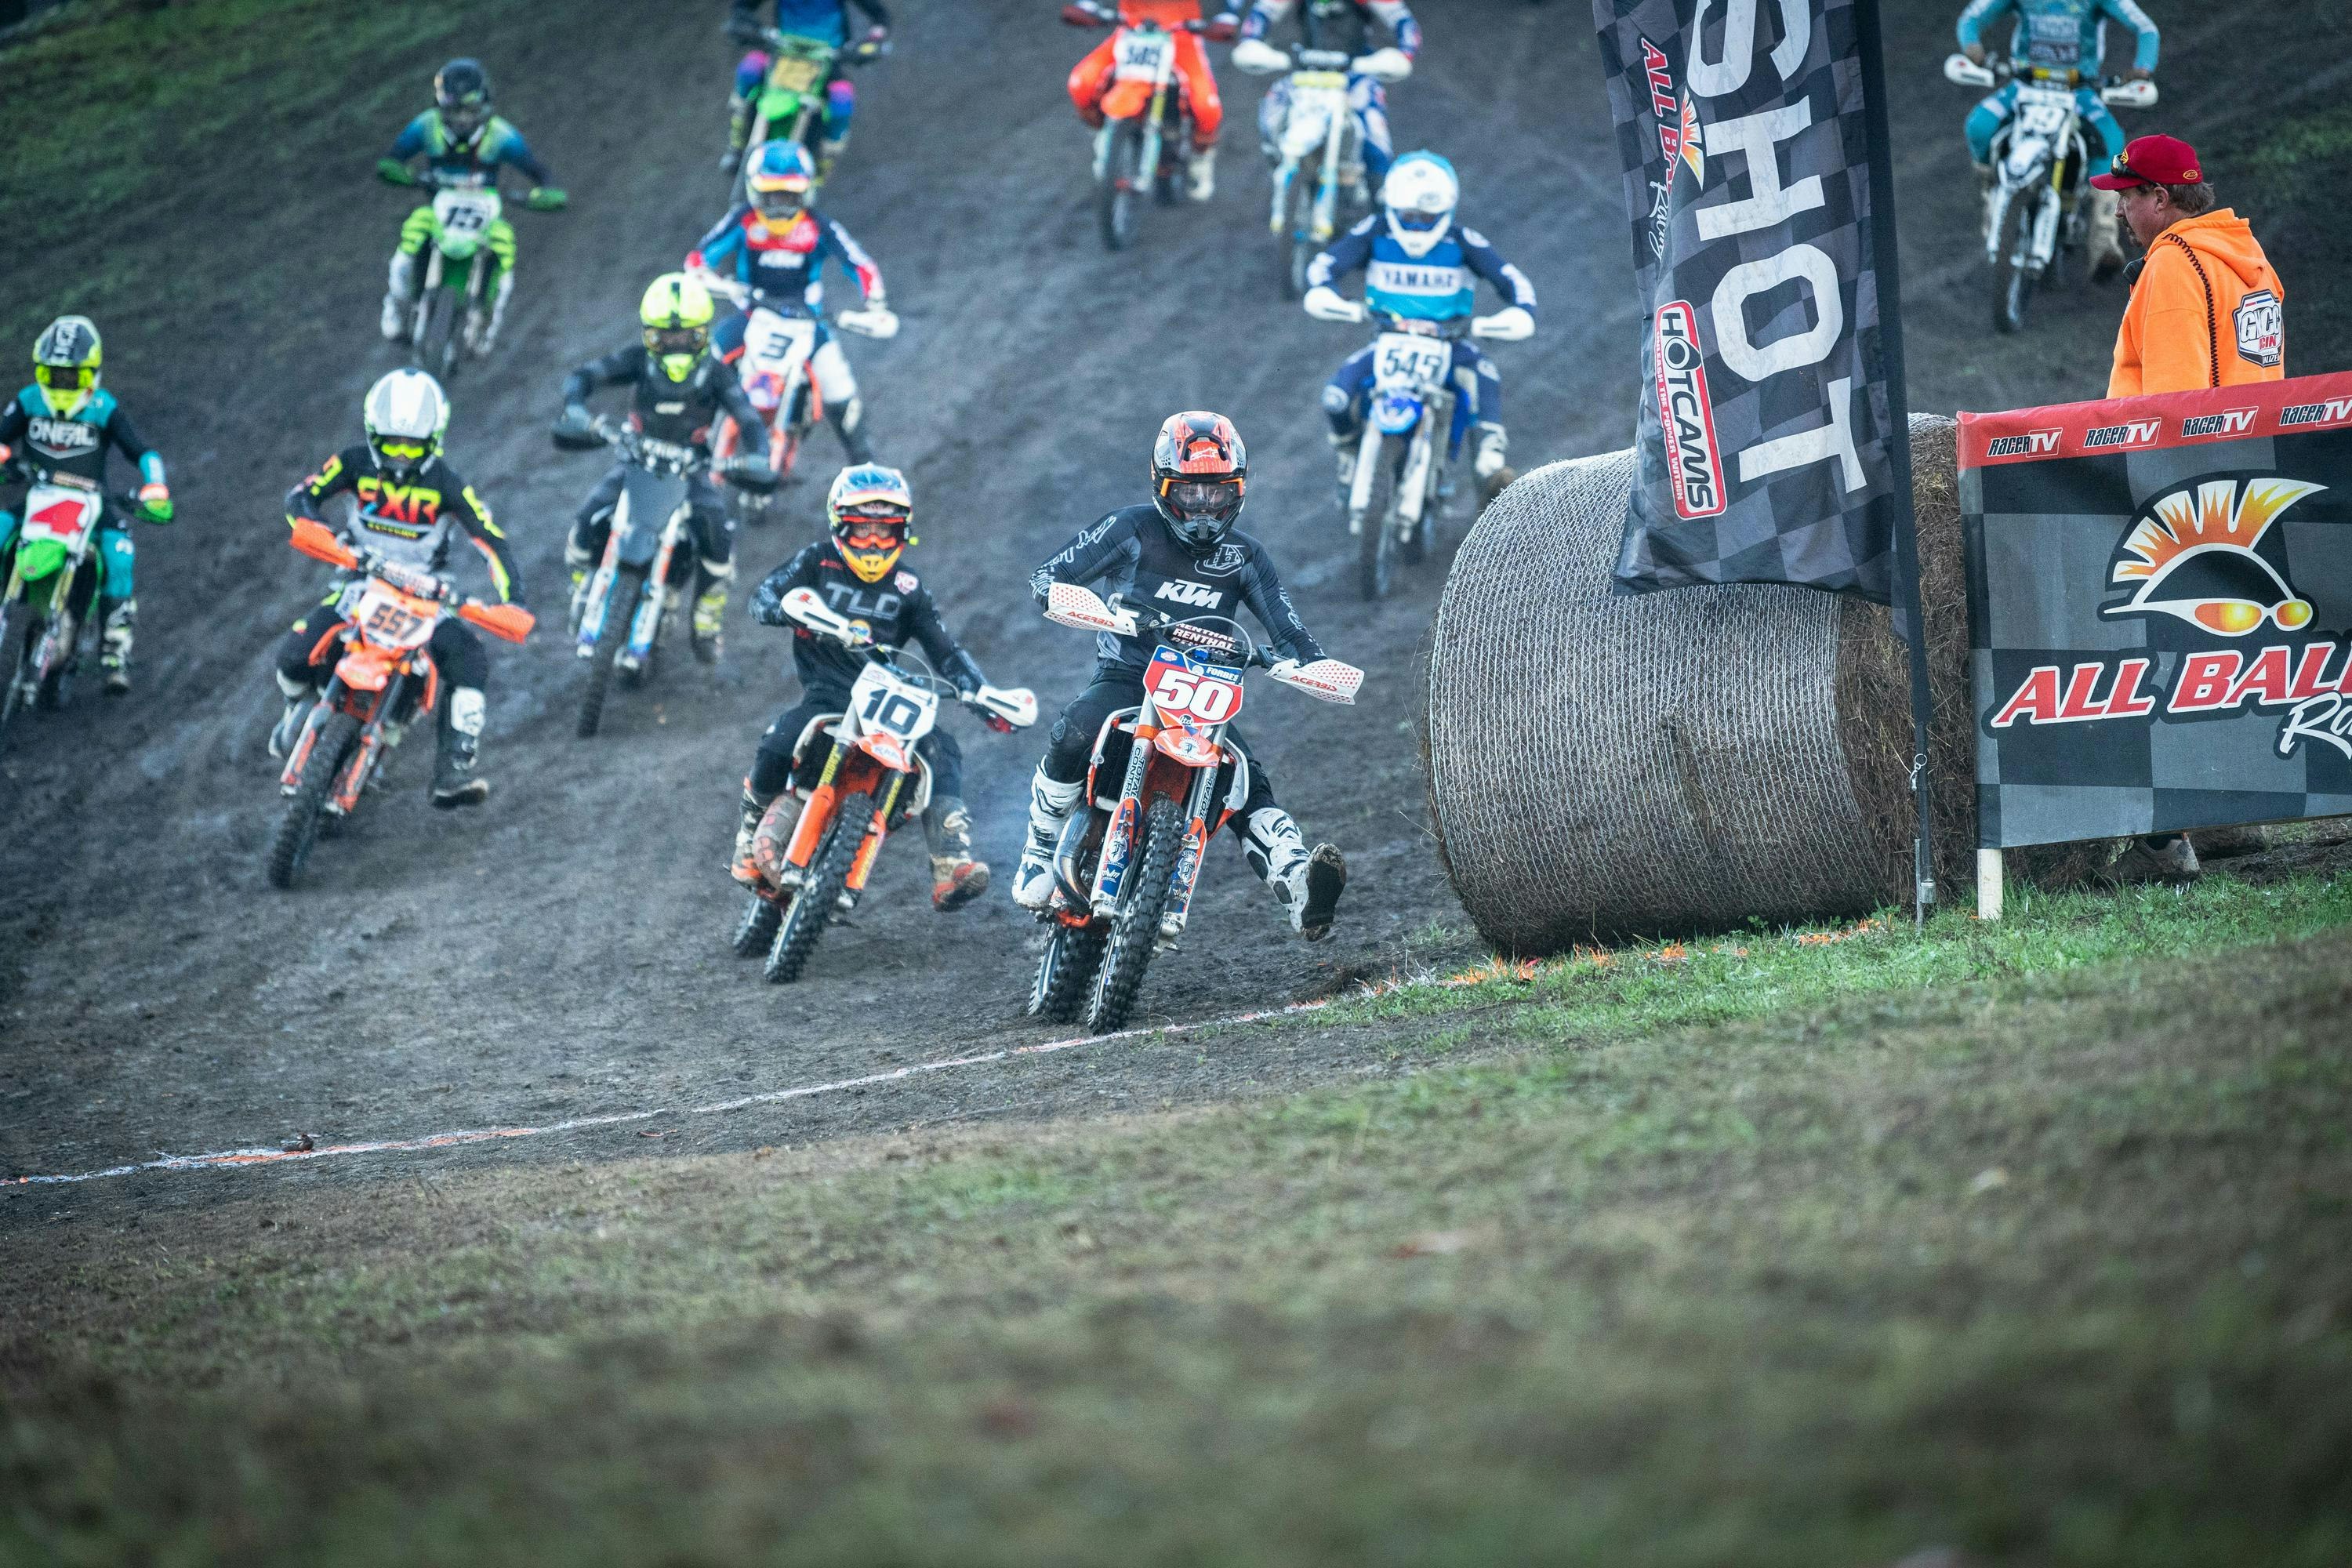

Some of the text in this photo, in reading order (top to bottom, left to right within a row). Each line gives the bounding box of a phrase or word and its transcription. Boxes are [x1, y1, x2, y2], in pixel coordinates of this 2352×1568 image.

[1641, 37, 1678, 118] ALL
[760, 332, 794, 360] 3
[1659, 386, 1668, 408] THE
[1663, 411, 1677, 454] POWER
[1672, 456, 1685, 501] WITHIN
[29, 499, 85, 535] 4
[358, 476, 441, 526] FXR
[826, 582, 901, 620] TLD
[1154, 579, 1223, 609] KTM
[1173, 628, 1239, 653] RENTHAL
[862, 688, 921, 735] 10
[1152, 669, 1234, 721] 50
[1991, 658, 2156, 728] ALL
[1124, 747, 1142, 799] CONTRO
